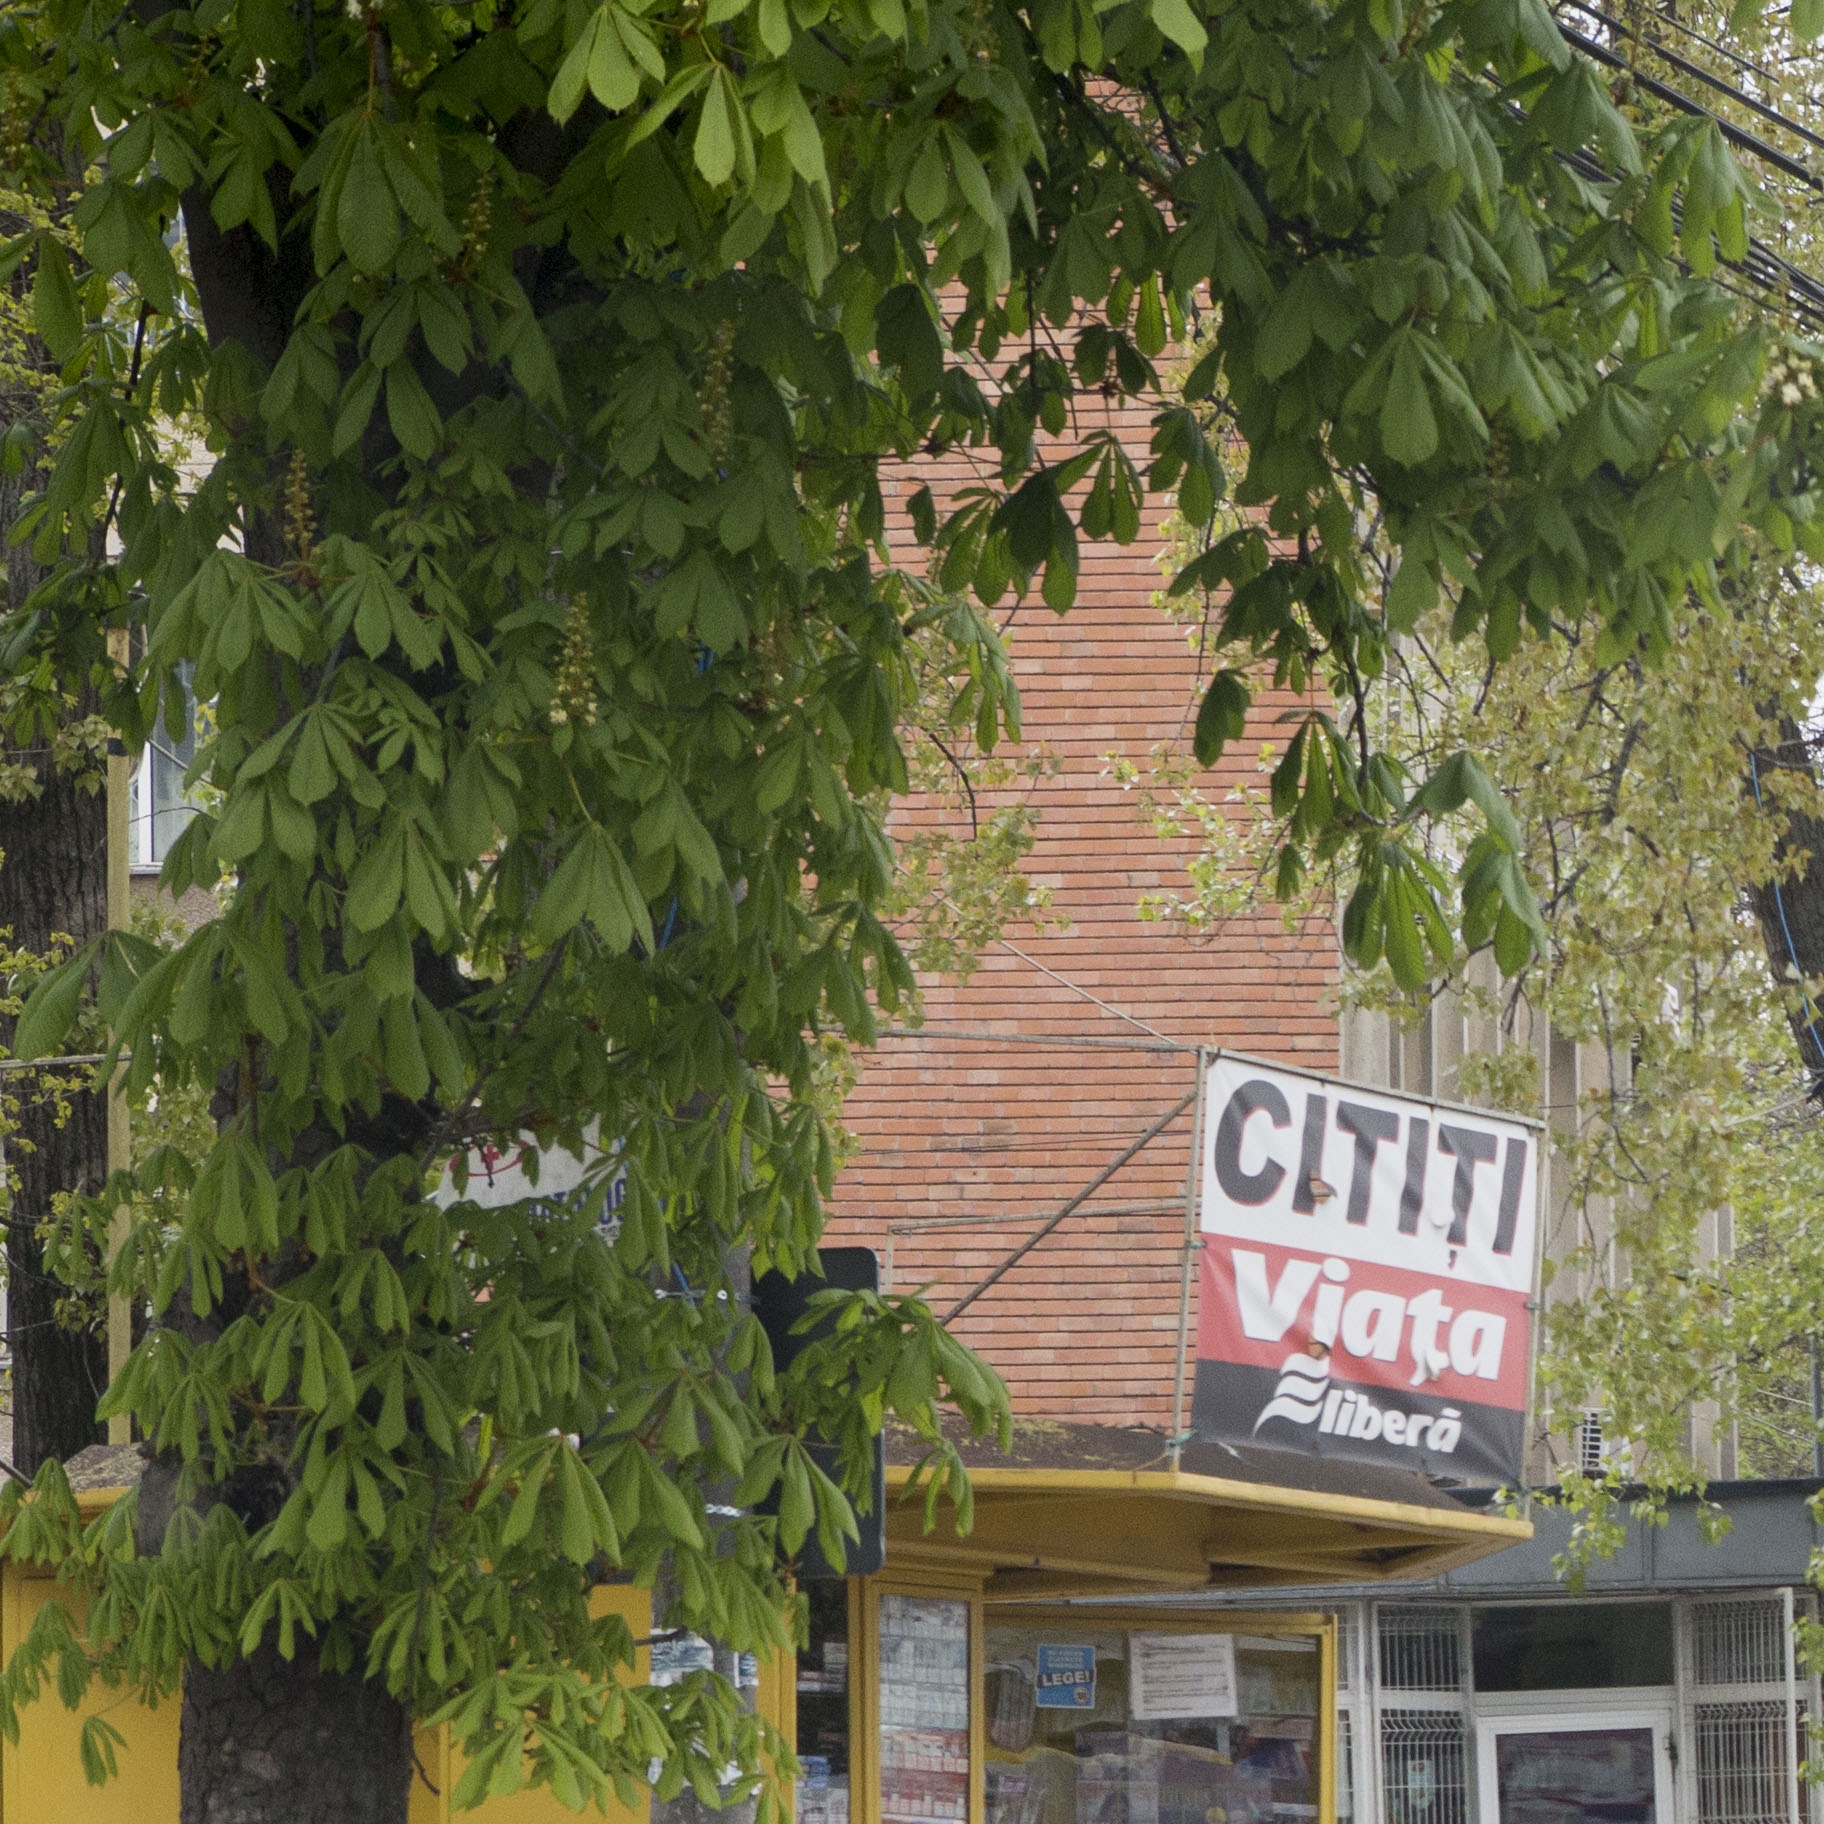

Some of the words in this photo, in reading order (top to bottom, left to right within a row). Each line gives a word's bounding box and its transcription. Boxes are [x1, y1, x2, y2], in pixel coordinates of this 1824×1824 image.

[1214, 1079, 1528, 1271] CITIȚI
[1317, 1388, 1463, 1454] liberă
[1041, 1669, 1091, 1687] LEGE!
